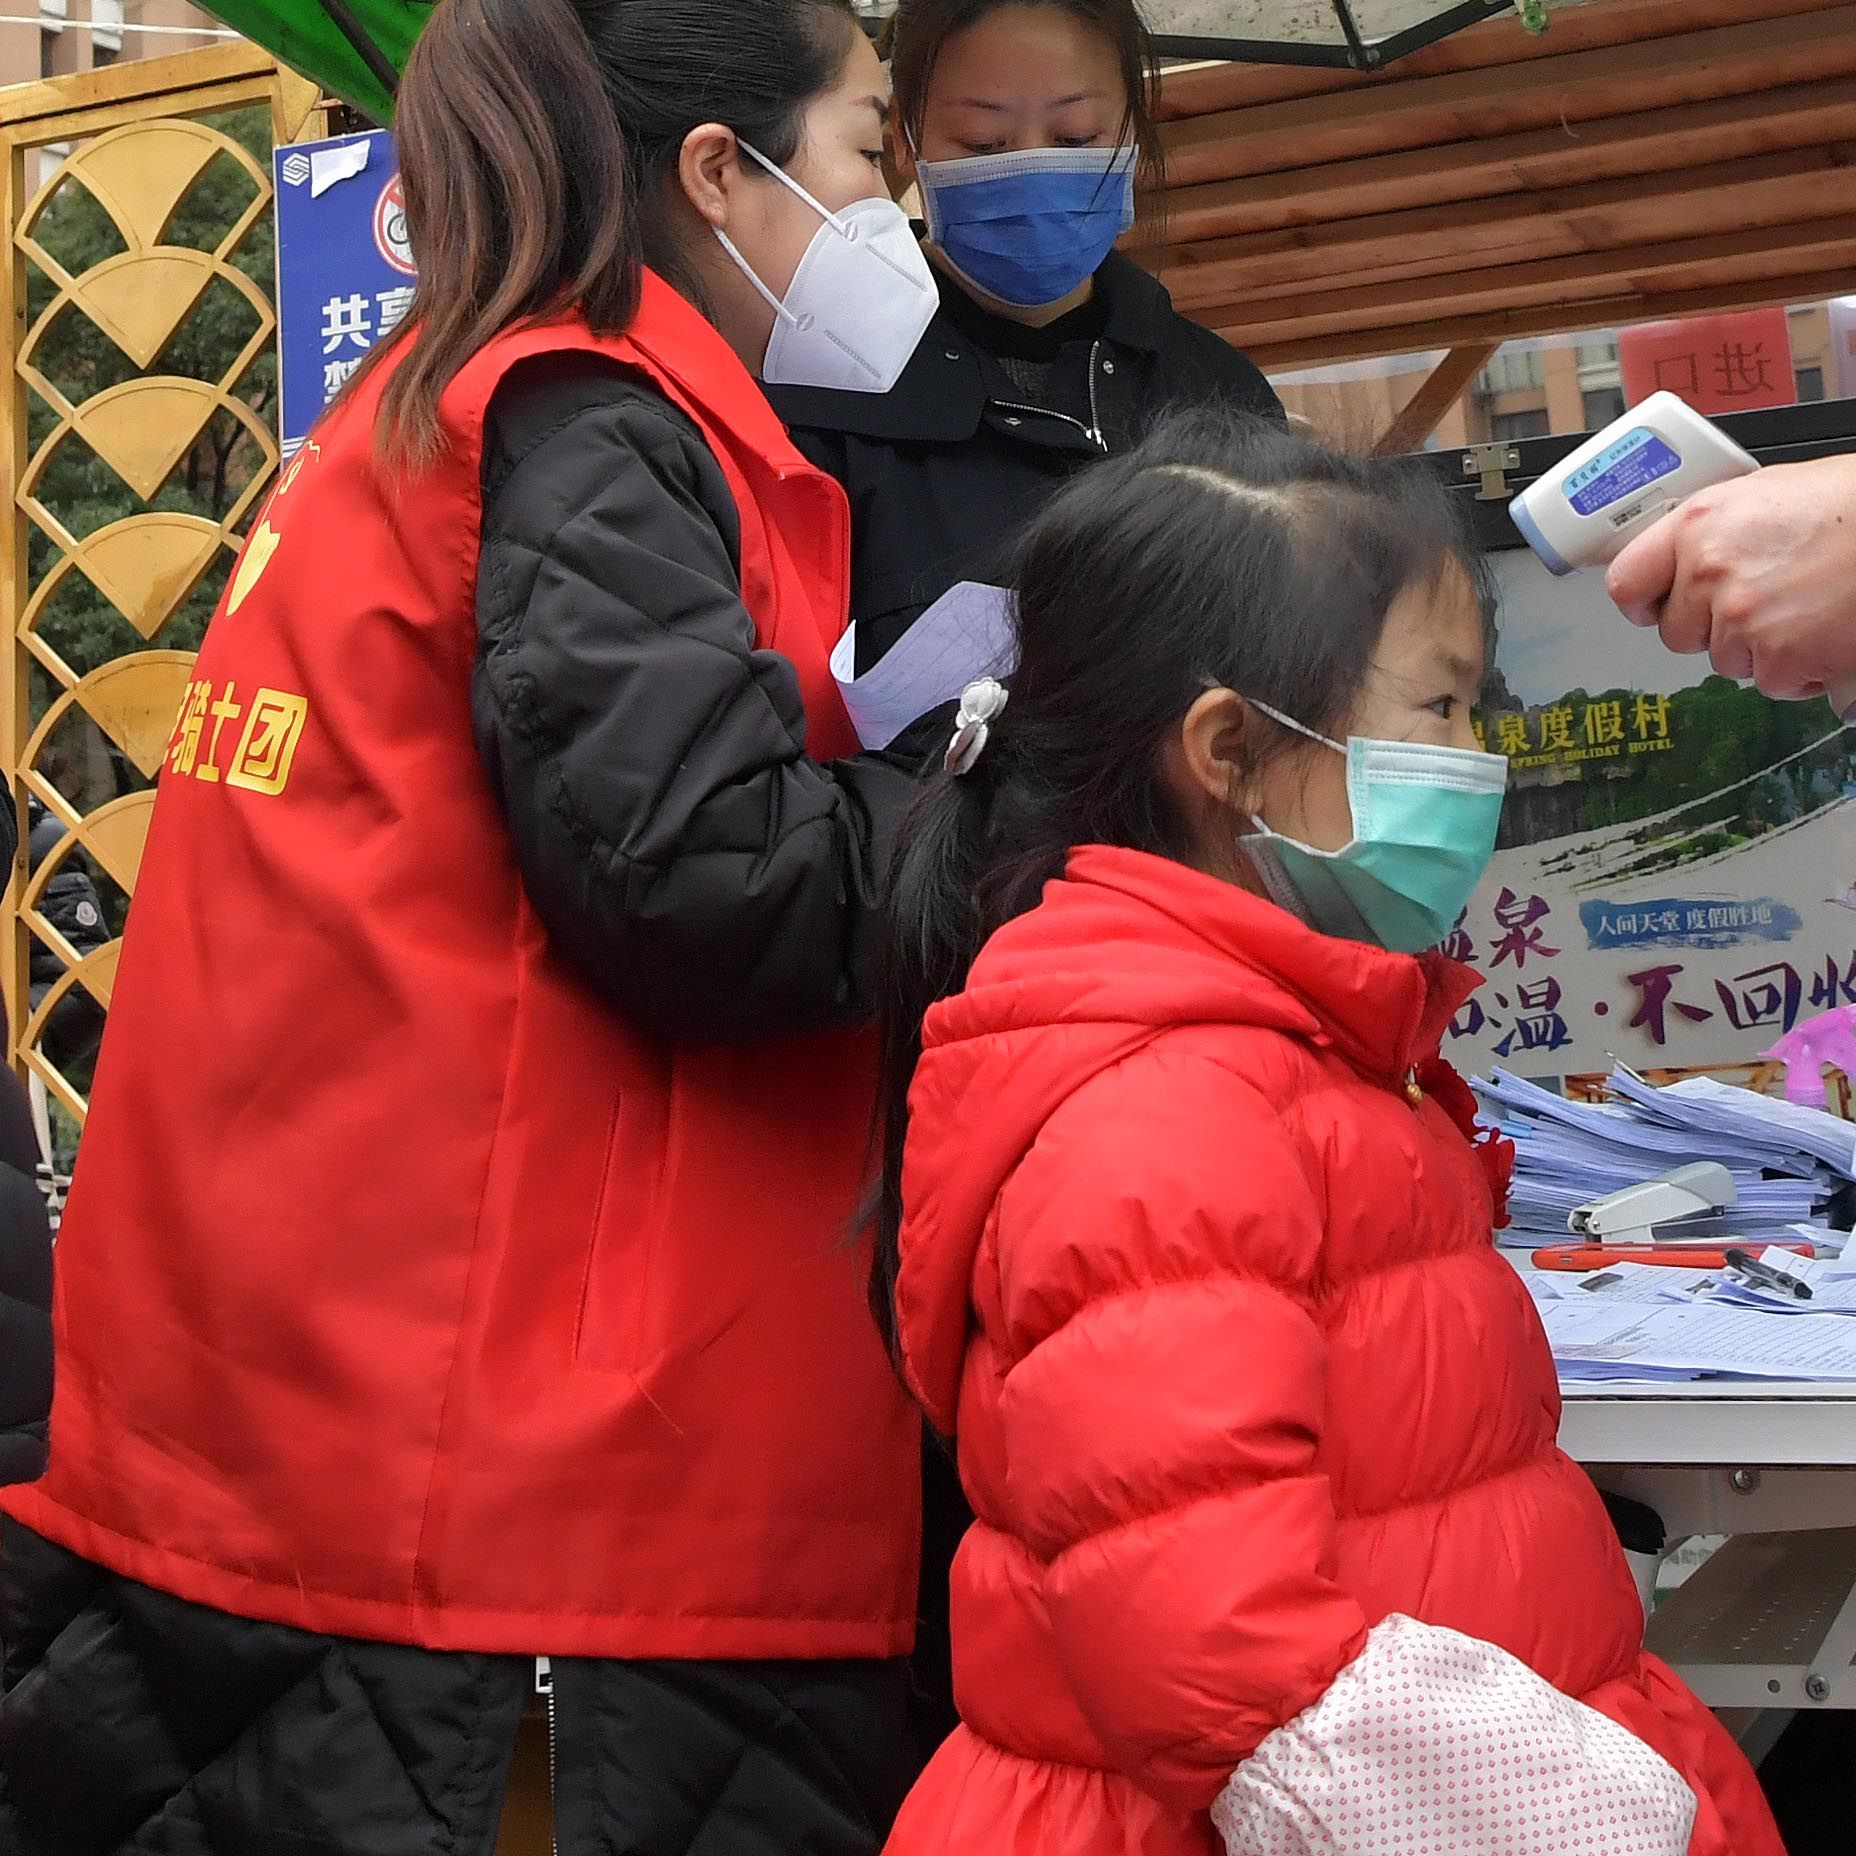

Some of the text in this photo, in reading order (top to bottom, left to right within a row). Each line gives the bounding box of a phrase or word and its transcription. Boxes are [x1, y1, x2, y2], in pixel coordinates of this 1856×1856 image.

[162, 679, 308, 796] 骑士团
[1564, 744, 1620, 762] HOLIDAY
[1628, 737, 1674, 754] HOTEL
